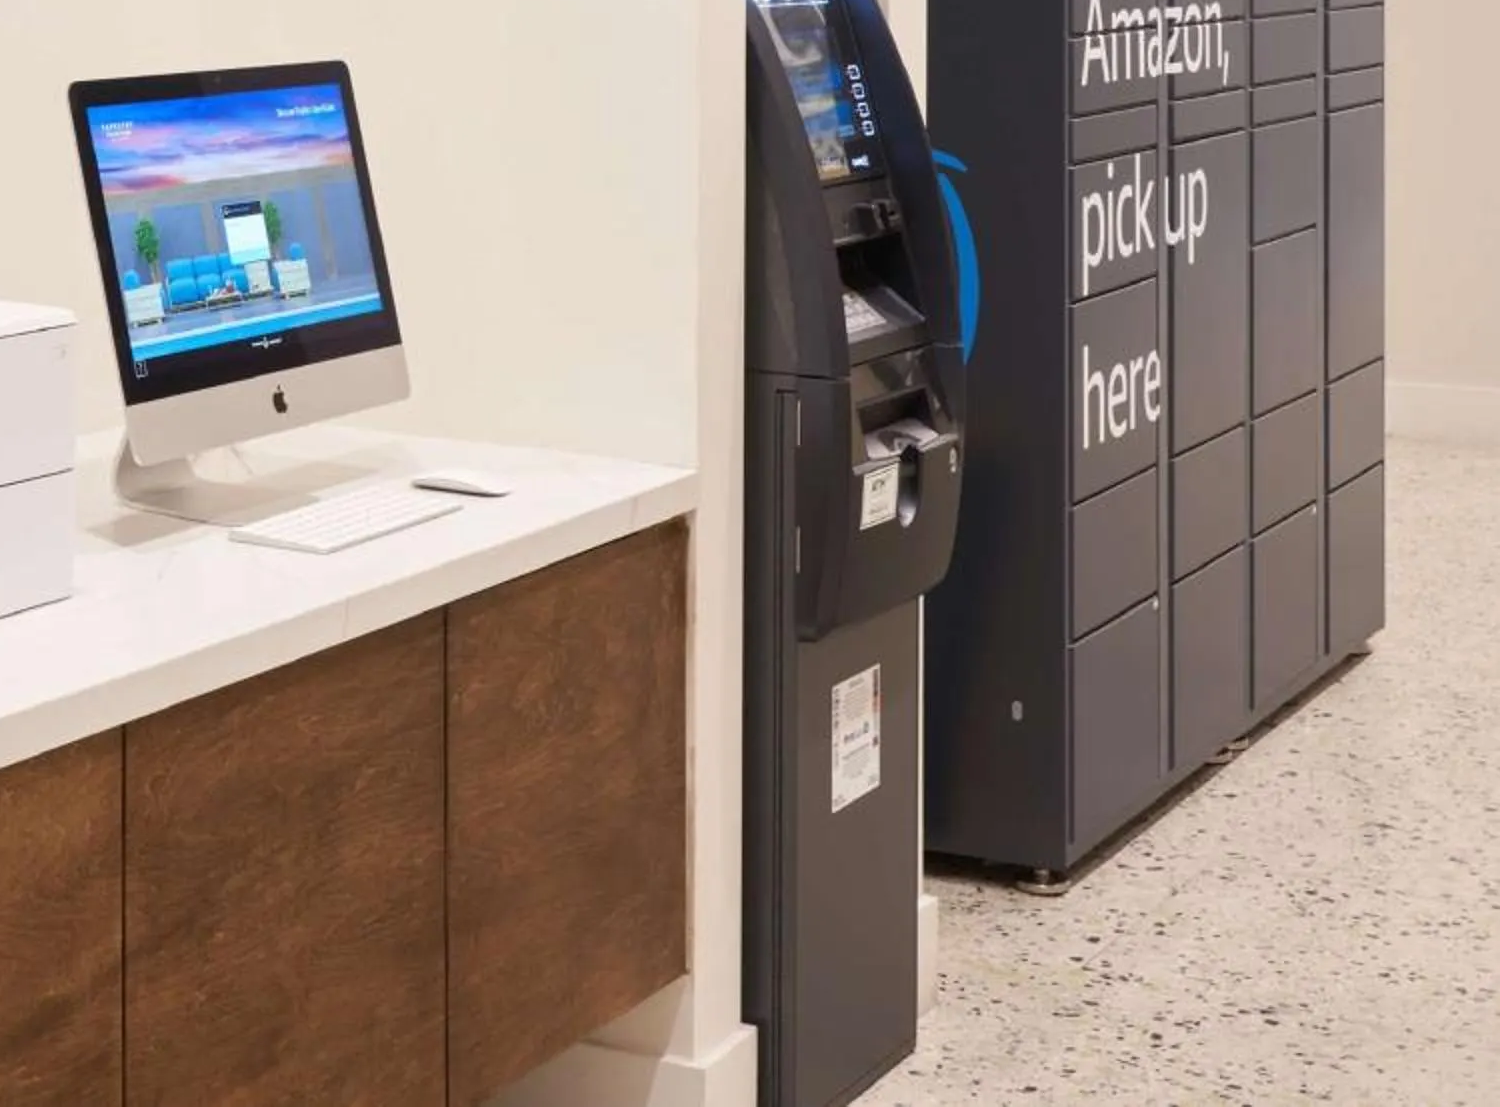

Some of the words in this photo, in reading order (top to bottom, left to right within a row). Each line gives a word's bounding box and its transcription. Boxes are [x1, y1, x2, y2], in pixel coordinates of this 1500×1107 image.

[1082, 153, 1155, 296] pick
[1163, 167, 1208, 265] up
[1083, 345, 1161, 449] here
